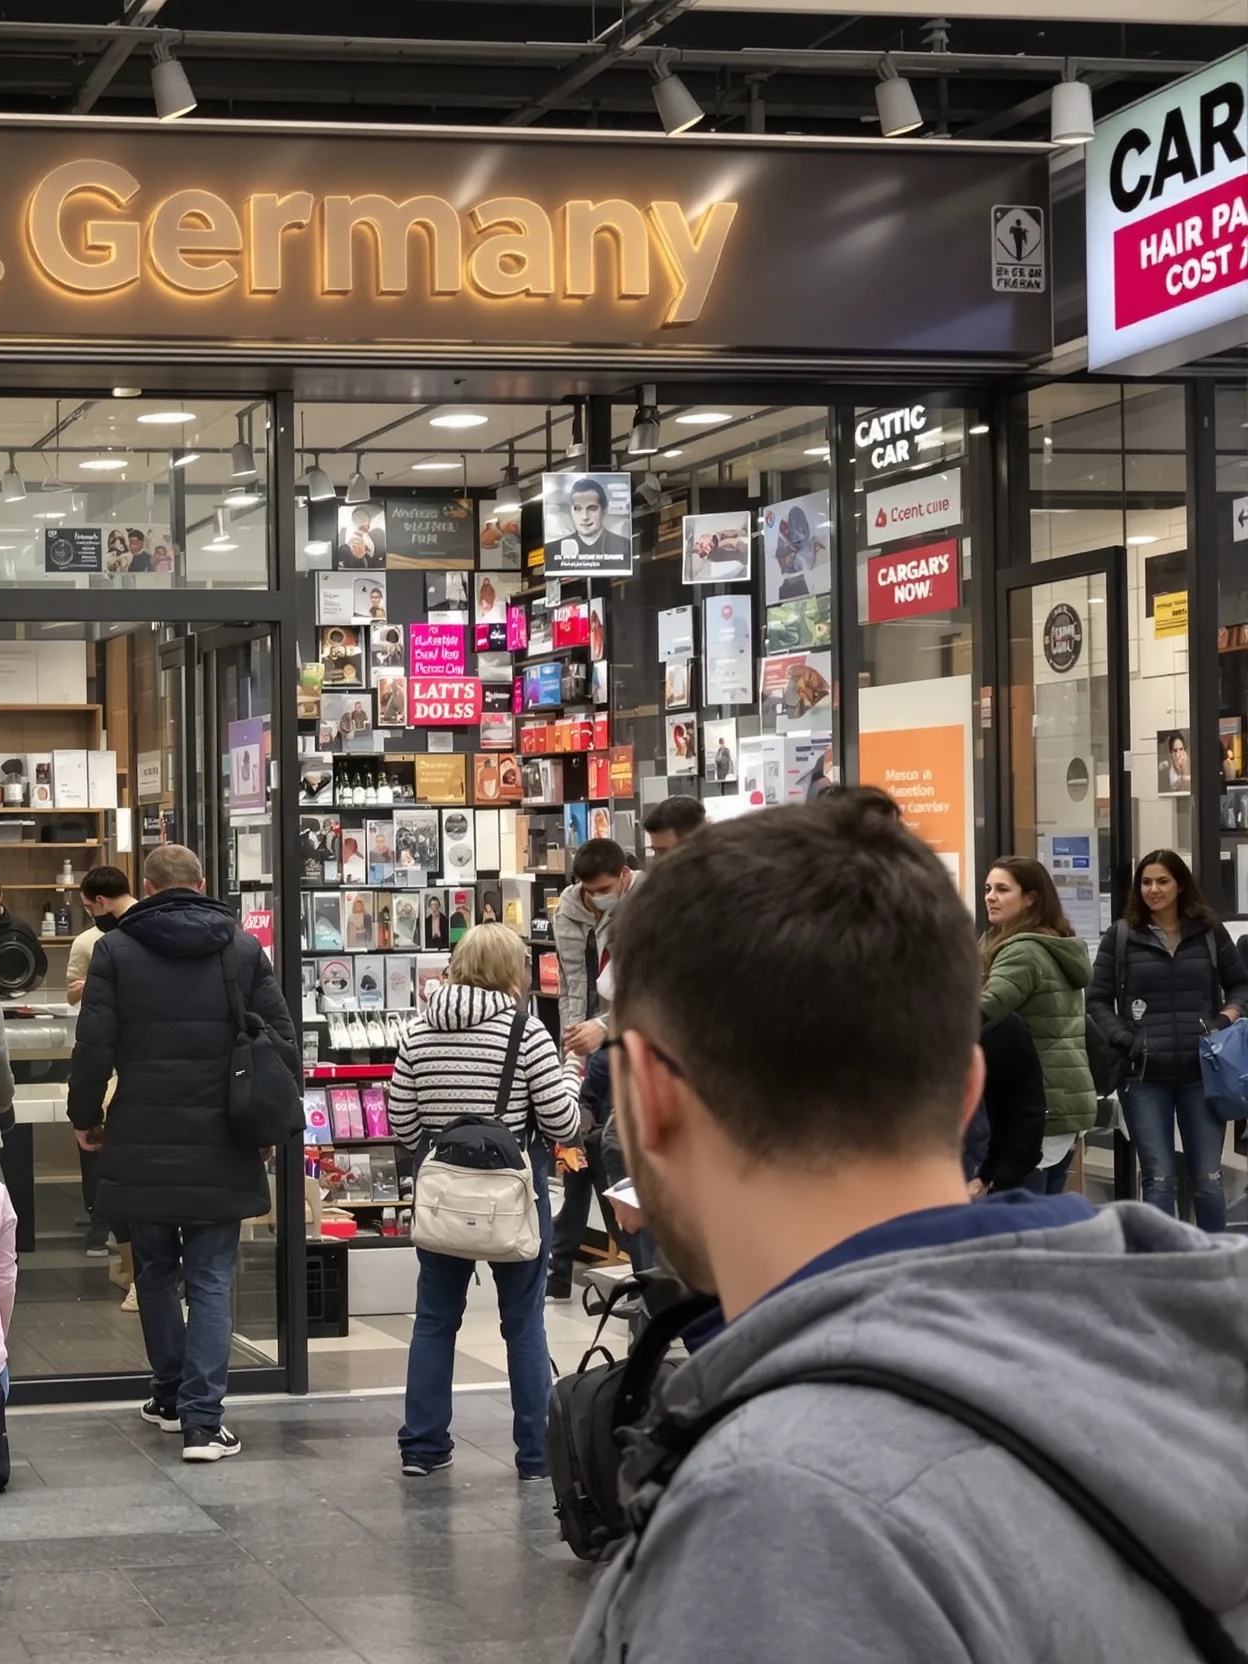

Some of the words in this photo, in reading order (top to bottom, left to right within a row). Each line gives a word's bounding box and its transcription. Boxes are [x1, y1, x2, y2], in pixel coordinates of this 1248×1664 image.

[1109, 81, 1247, 213] CAR
[27, 157, 739, 329] Germany
[1140, 215, 1204, 270] HAIR
[1165, 243, 1233, 296] COST
[871, 439, 910, 469] CAR
[413, 682, 475, 700] LATTS
